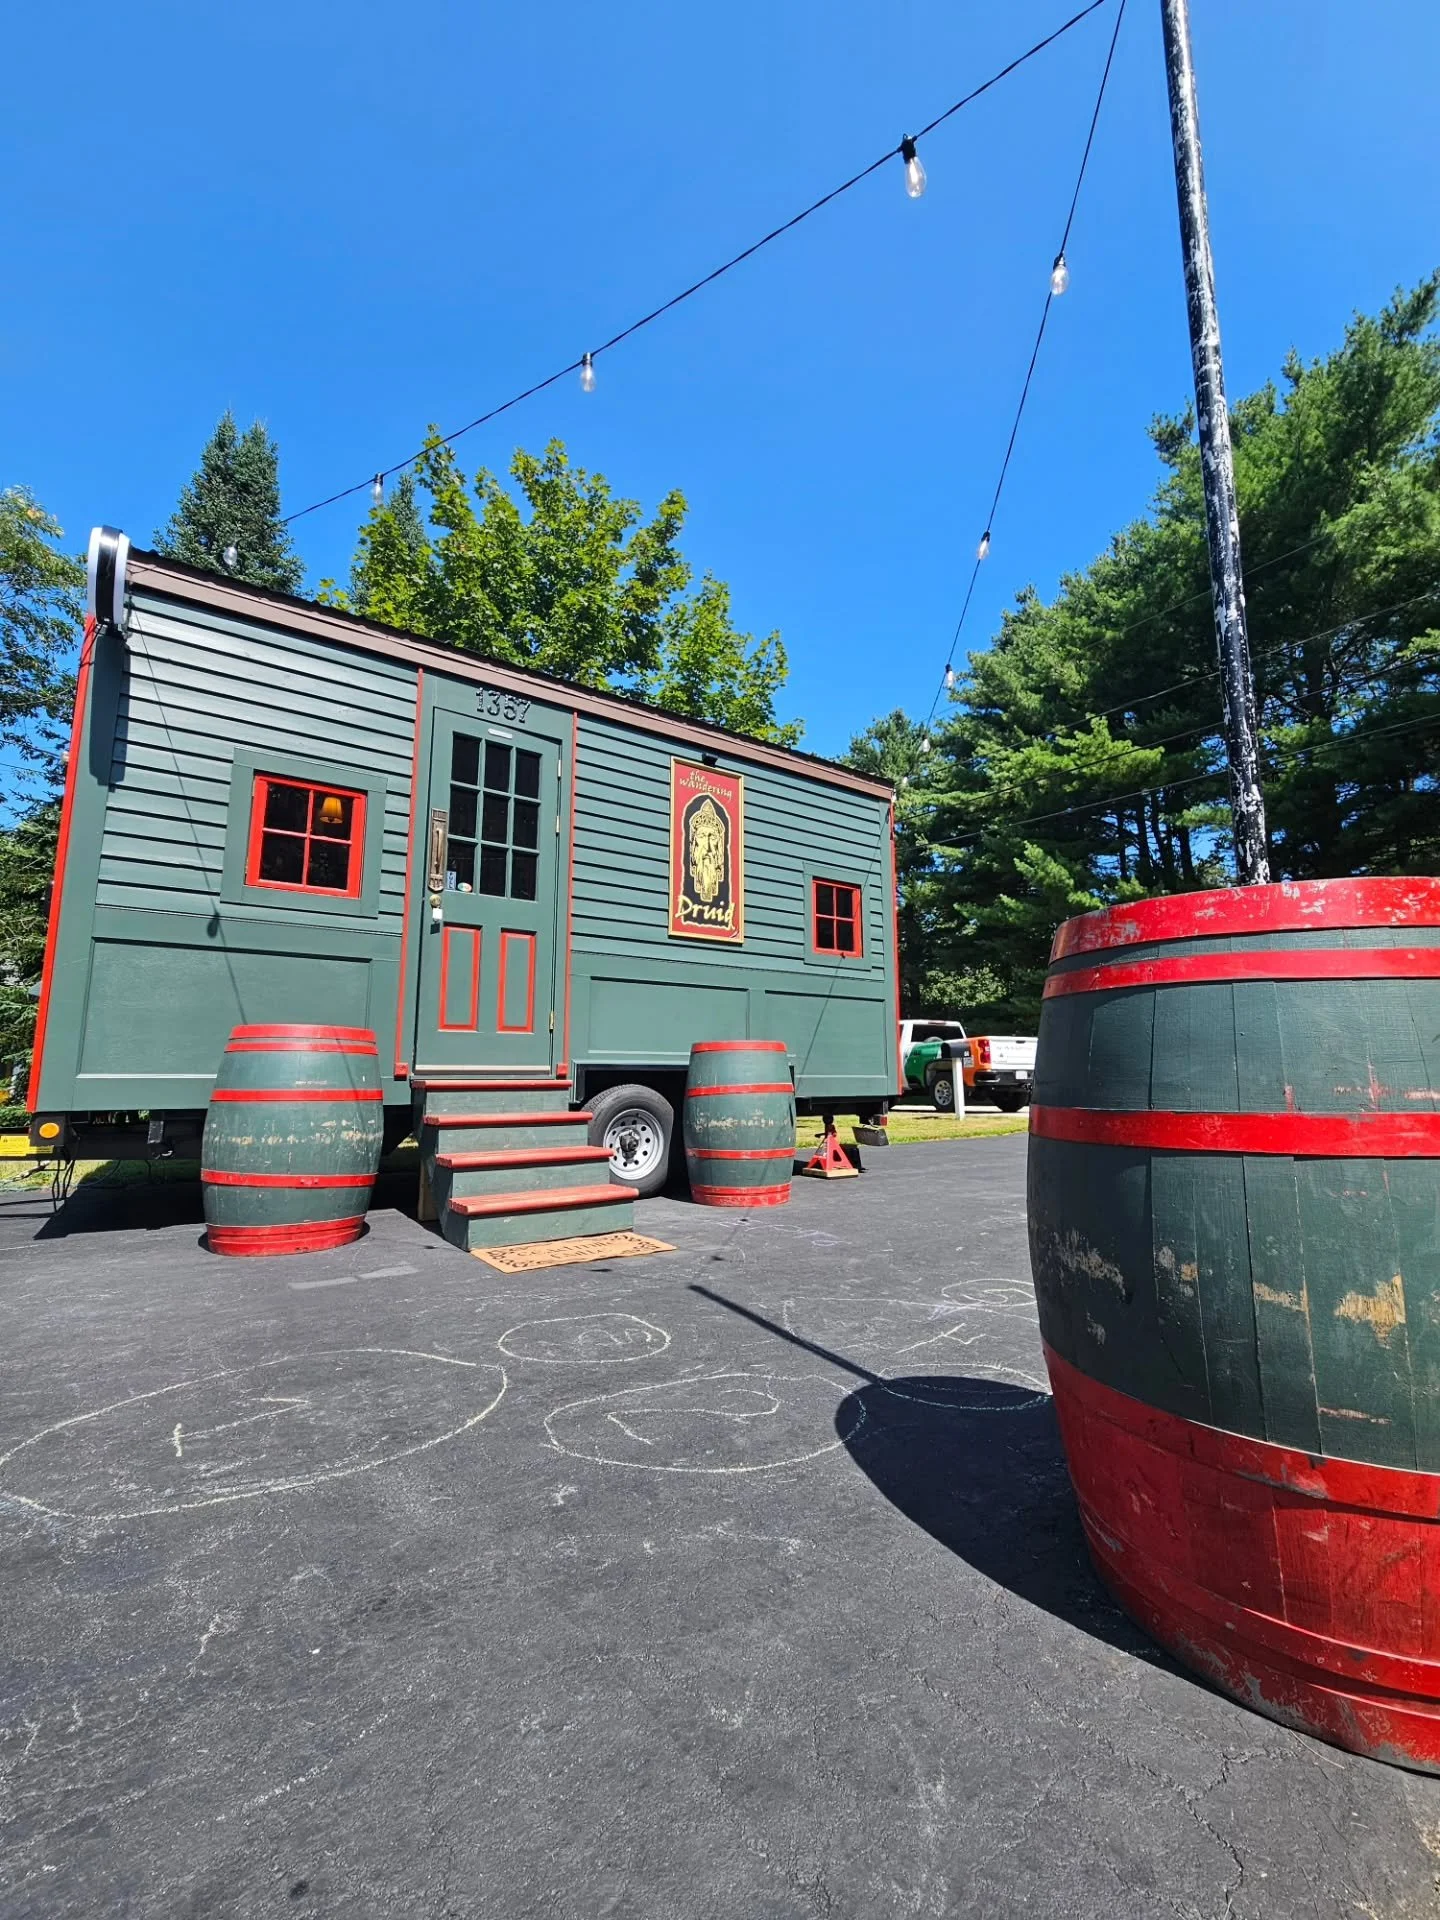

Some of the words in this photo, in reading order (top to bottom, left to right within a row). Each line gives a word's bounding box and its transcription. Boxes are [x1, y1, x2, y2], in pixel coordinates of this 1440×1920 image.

[475, 687, 532, 723] 1357
[689, 769, 706, 783] the
[675, 895, 735, 931] Druid
